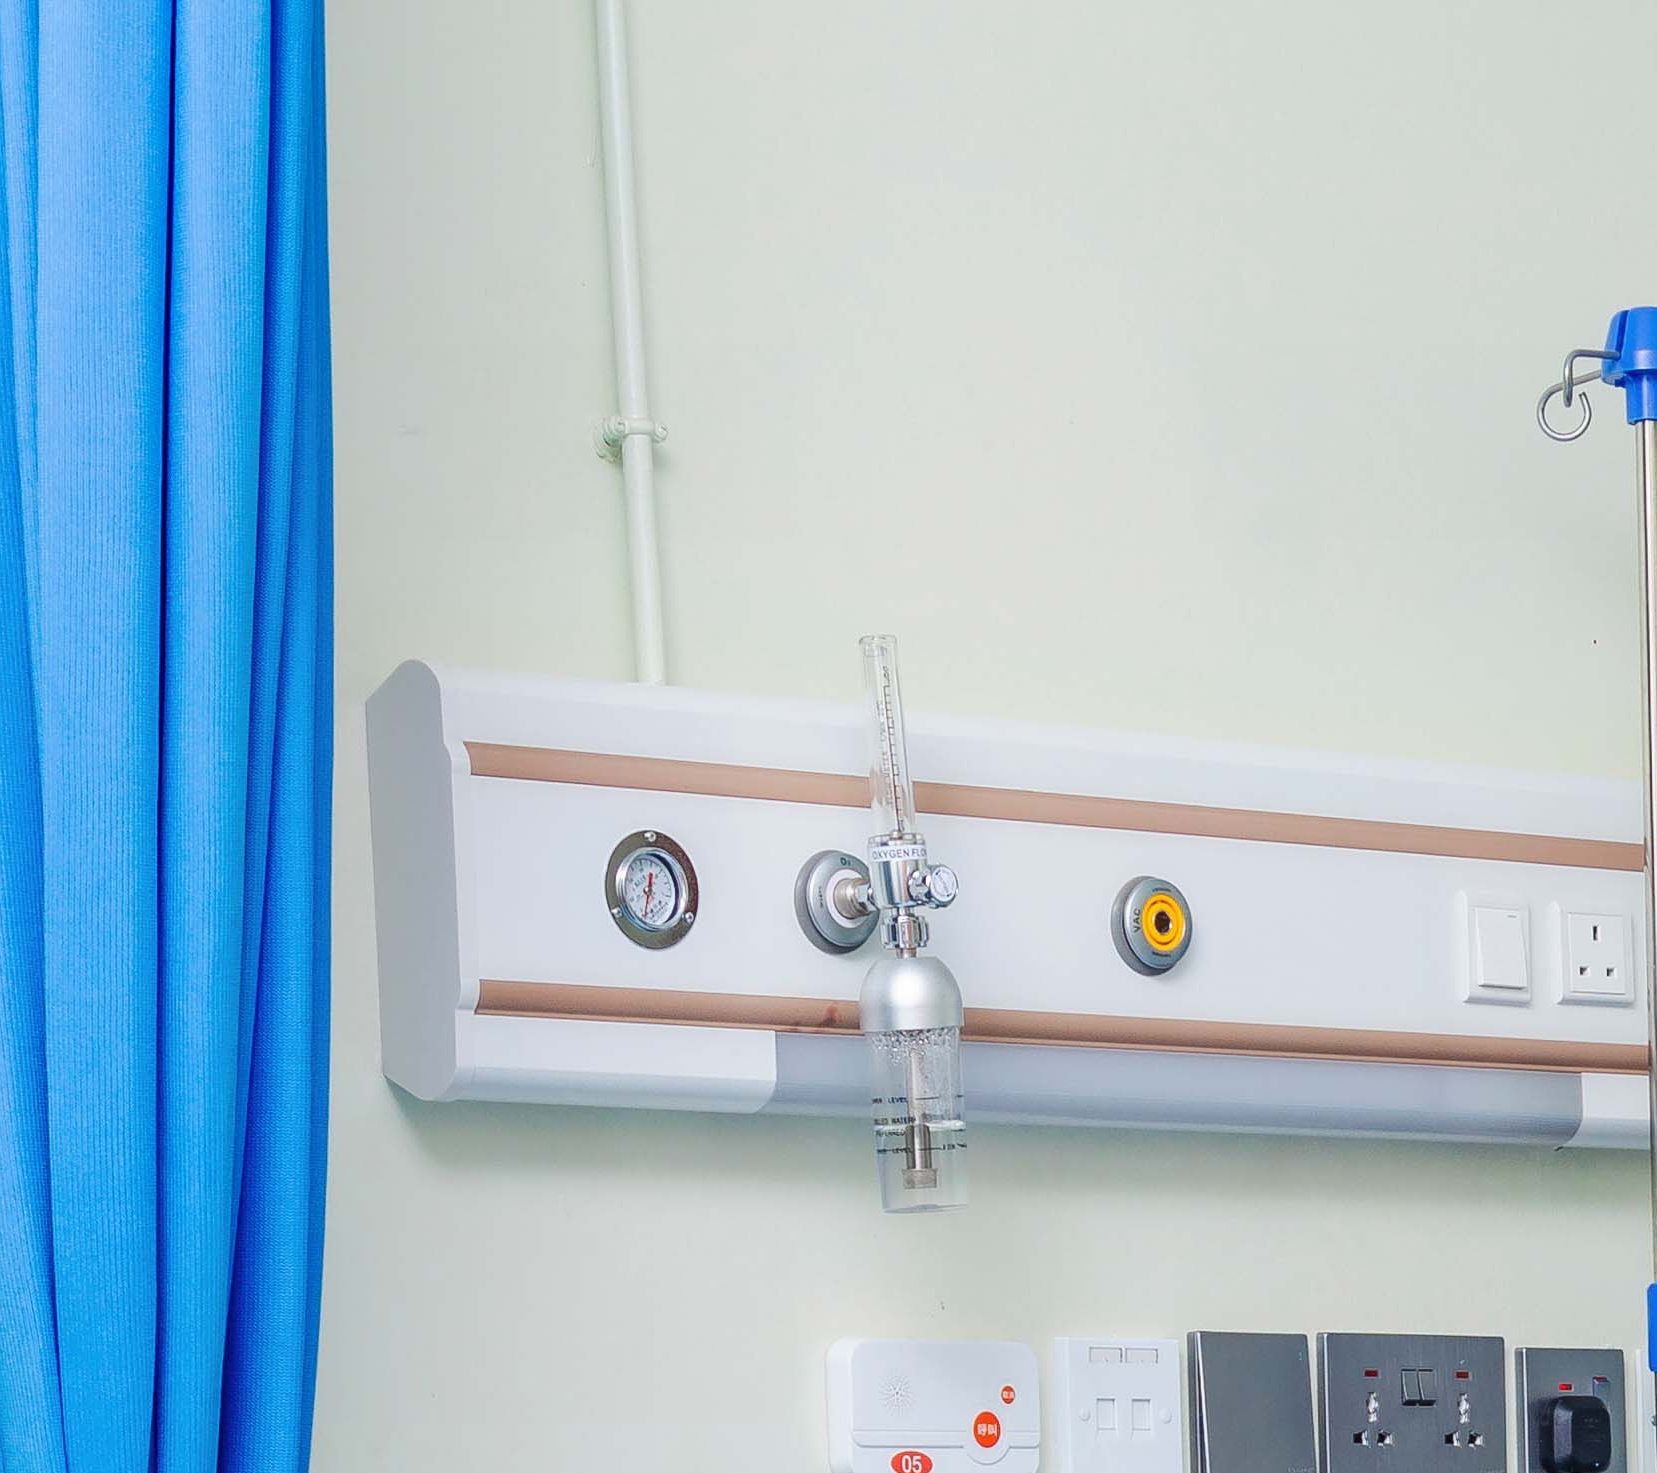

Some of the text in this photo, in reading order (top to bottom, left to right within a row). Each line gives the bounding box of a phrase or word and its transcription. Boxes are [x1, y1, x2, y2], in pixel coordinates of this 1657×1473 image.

[871, 848, 911, 861] OXYGEN
[1133, 907, 1142, 934] VAC
[901, 1455, 923, 1473] 05
